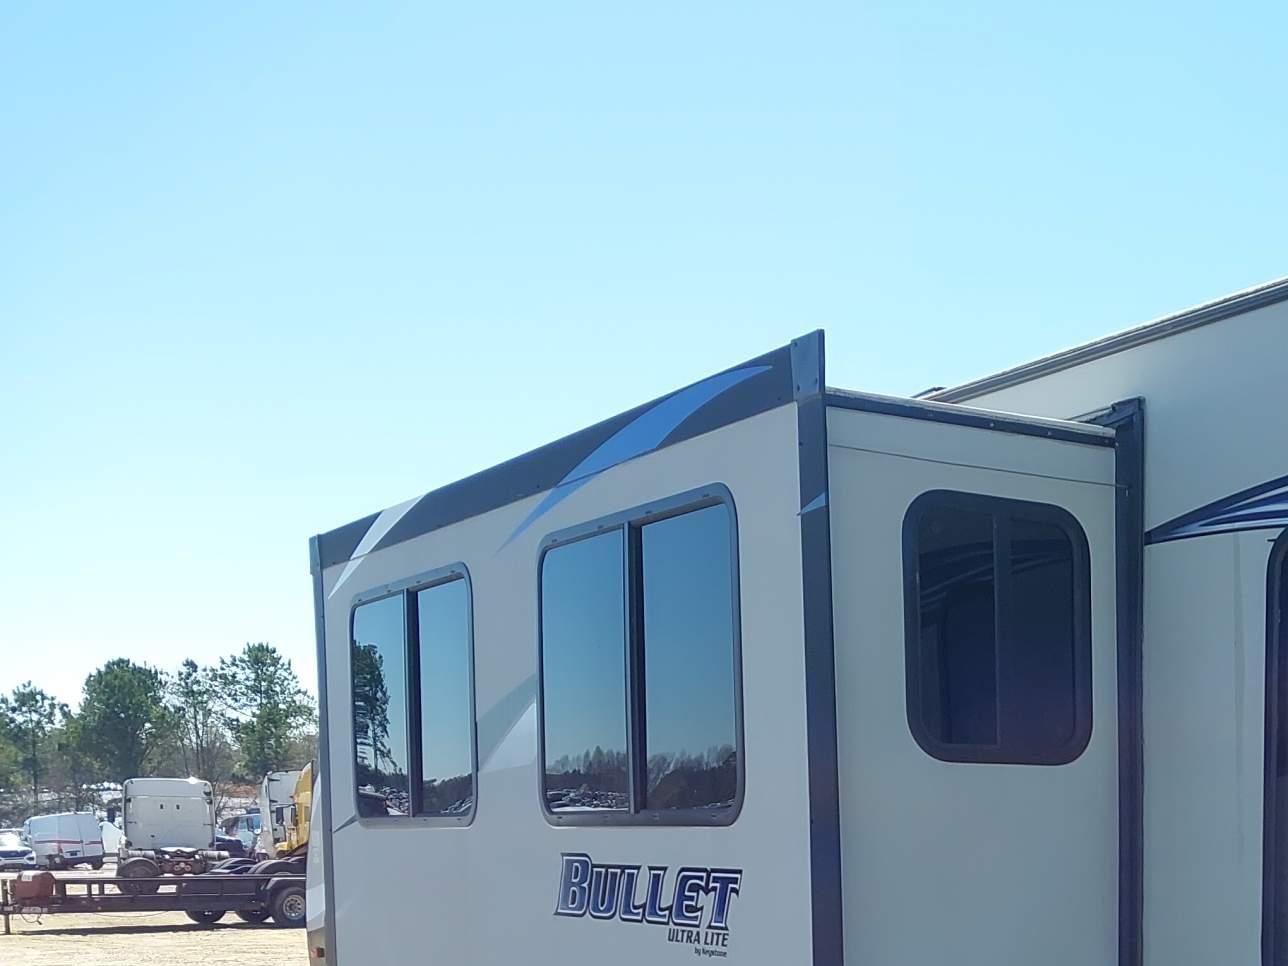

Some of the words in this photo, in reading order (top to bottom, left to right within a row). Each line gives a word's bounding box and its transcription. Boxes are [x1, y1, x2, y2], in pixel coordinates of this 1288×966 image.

[553, 852, 743, 931] BULLET
[668, 928, 700, 945] ULTRA
[703, 930, 730, 947] LITE
